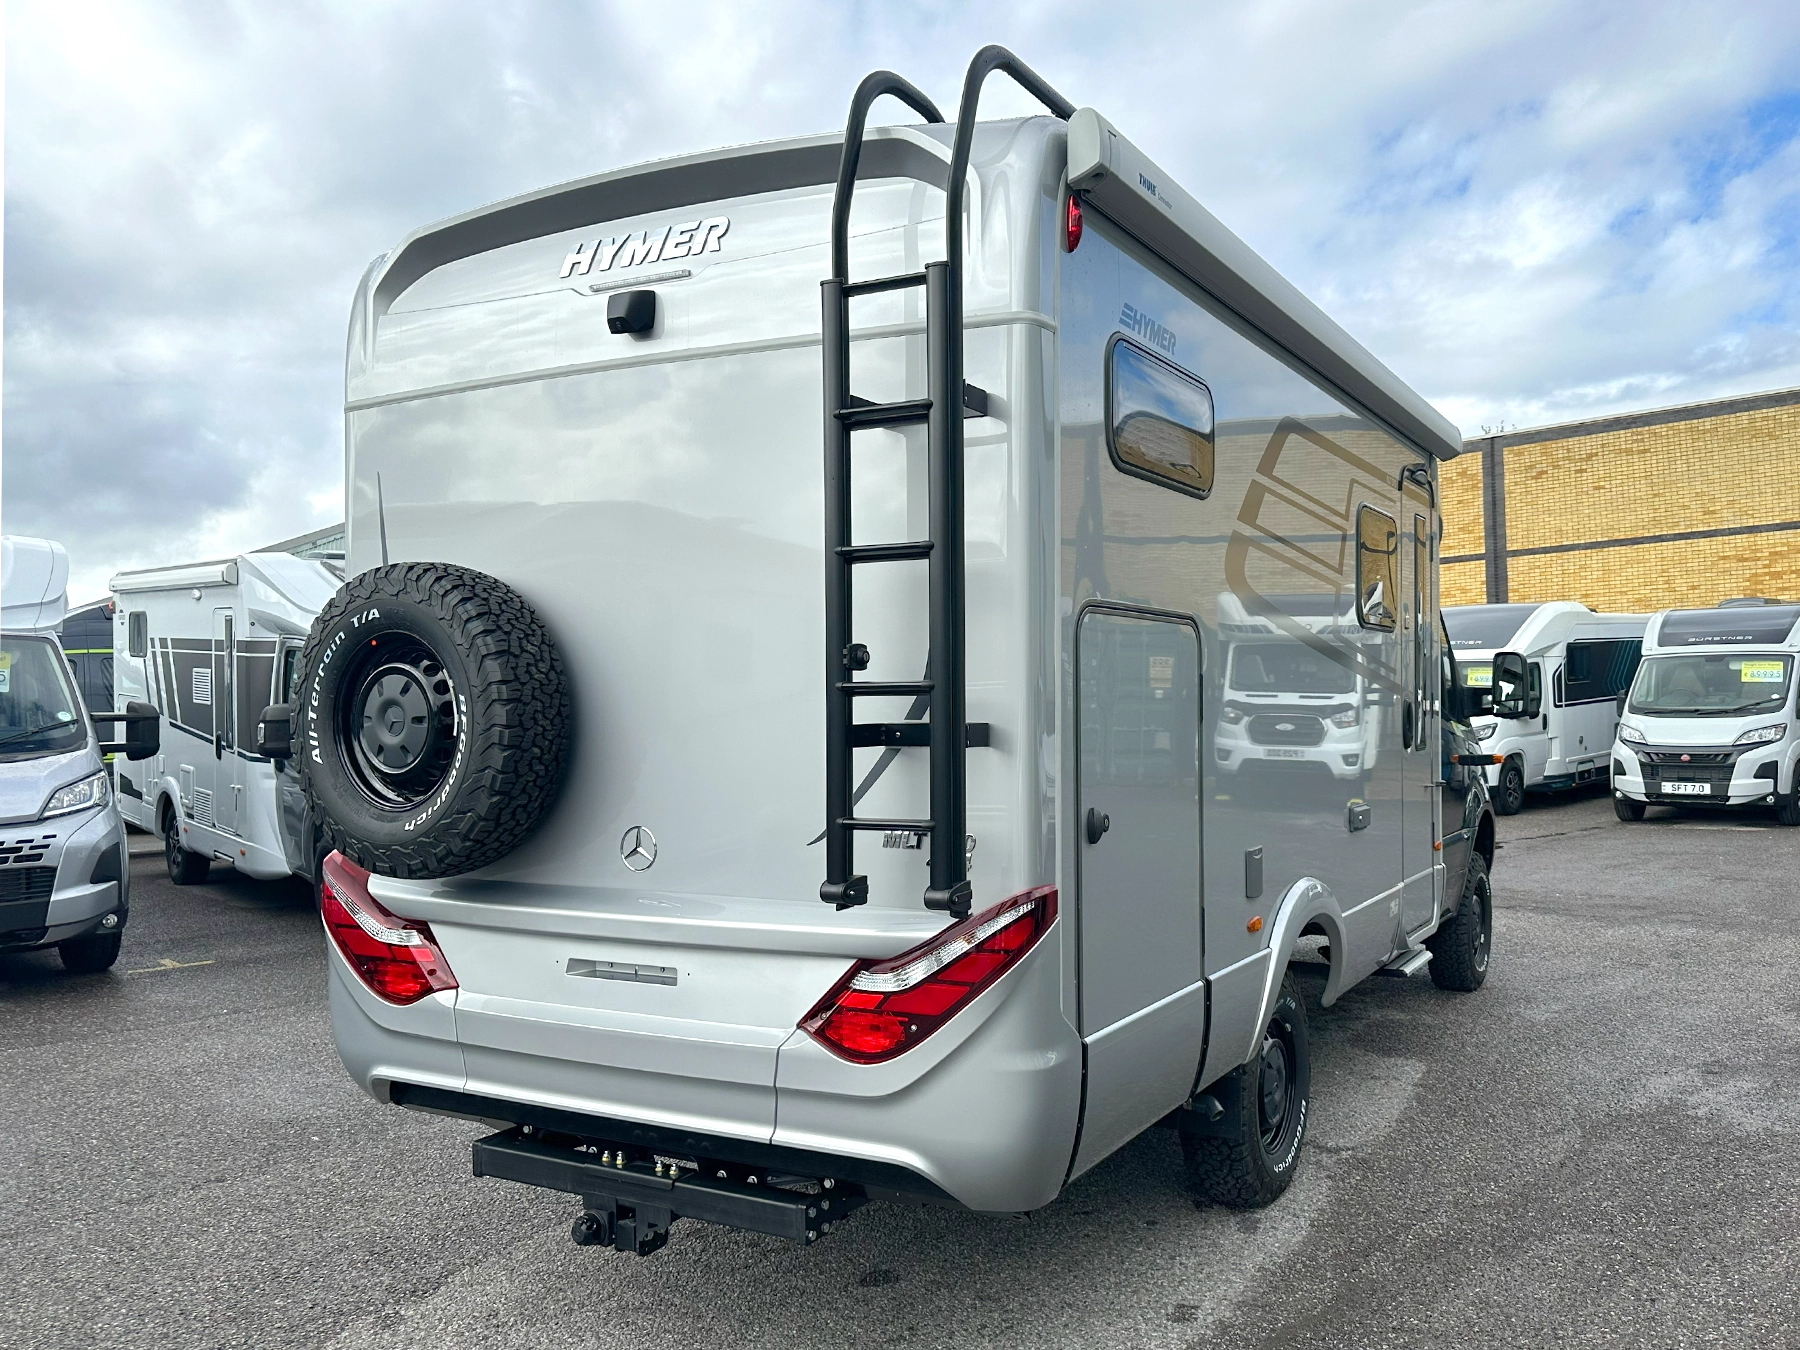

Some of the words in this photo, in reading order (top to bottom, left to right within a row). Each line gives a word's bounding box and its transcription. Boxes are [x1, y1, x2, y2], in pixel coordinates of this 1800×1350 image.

[1138, 172, 1157, 194] THULE
[559, 216, 730, 279] HYMER
[1132, 309, 1177, 356] HYMER
[308, 630, 346, 765] All-Terrain
[350, 607, 381, 629] T/A
[404, 693, 468, 832] BFGoodrich
[1671, 783, 1688, 792] SFT
[882, 830, 928, 850] MLT
